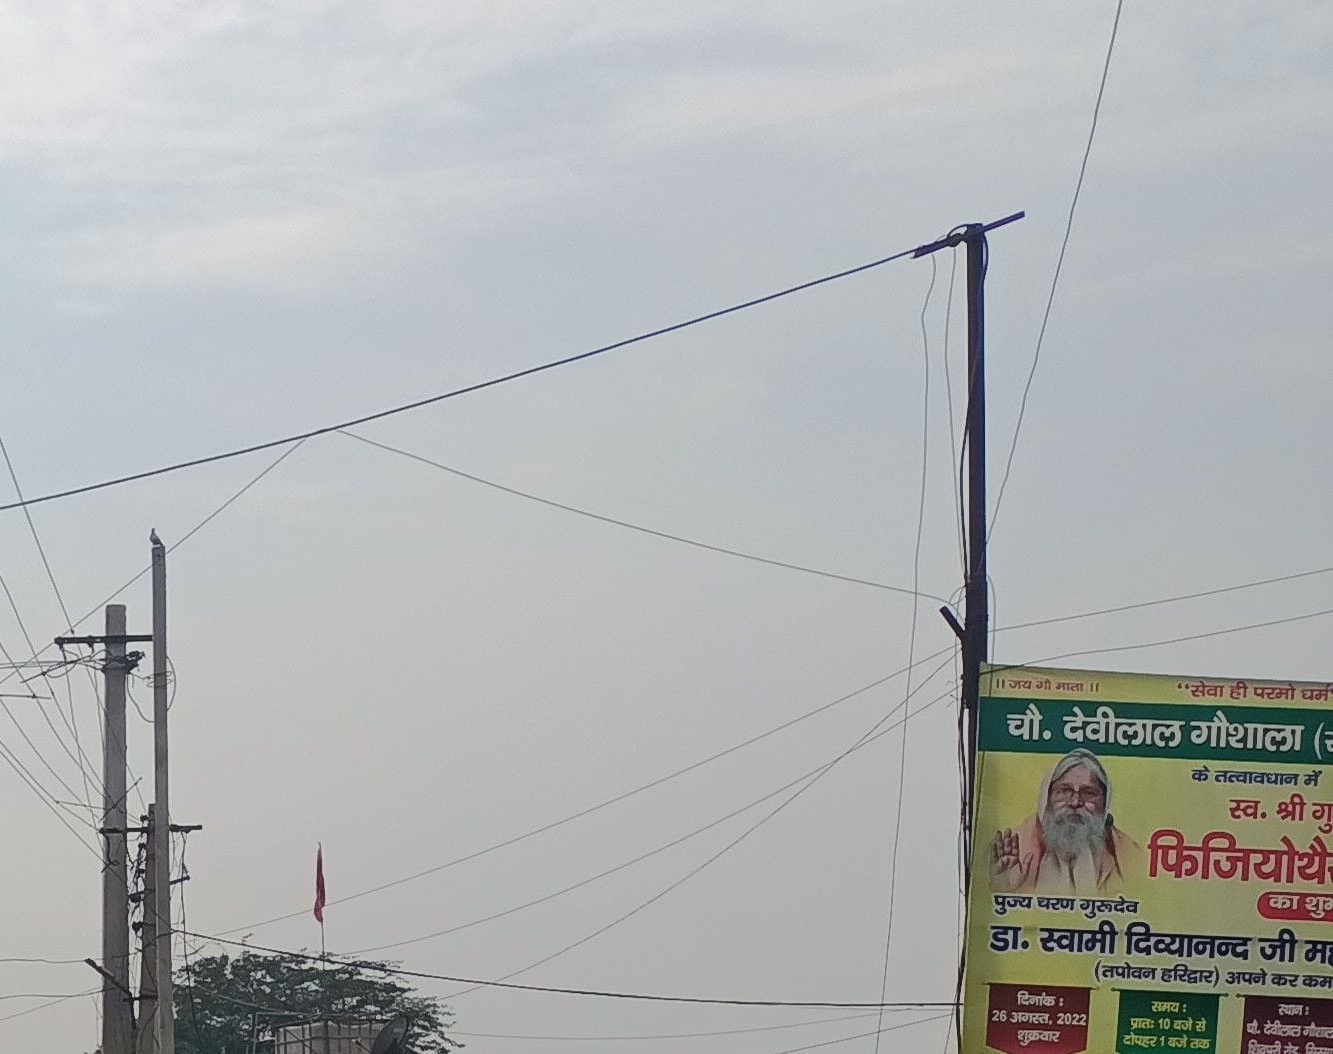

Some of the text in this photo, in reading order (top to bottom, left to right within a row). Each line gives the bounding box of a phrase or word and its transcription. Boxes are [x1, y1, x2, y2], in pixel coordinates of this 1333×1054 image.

[1008, 678, 1032, 690] जय
[1055, 681, 1084, 692] माता
[1229, 680, 1248, 699] ही
[1253, 683, 1297, 701] परमो
[1006, 702, 1052, 741] चौ.
[1062, 705, 1186, 748] देवीलाल
[1190, 709, 1305, 752] गौशाला
[1191, 765, 1322, 787] के तत्वावधान में
[1228, 798, 1267, 820] स्व.
[1275, 793, 1307, 822] श्री
[1037, 896, 1076, 911] चरण
[1268, 894, 1299, 910] का
[990, 925, 1030, 952] डा.
[1039, 920, 1118, 954] स्वामी
[1124, 921, 1252, 960] दिव्यानन्द
[1258, 928, 1298, 962] जी
[1095, 960, 1157, 981] (तपोवन
[1160, 963, 1220, 987] हरिद्वार)
[1225, 968, 1267, 985] अपने
[1271, 973, 1299, 987] कर
[1017, 990, 1057, 1007] दिनांक
[1150, 1000, 1180, 1013] समय
[991, 1009, 1087, 1026] 26 अगस्त, 2022
[1278, 1003, 1304, 1016] स्थान
[1158, 1018, 1171, 1030] 10
[1173, 1017, 1193, 1031] बजे
[1195, 1018, 1207, 1032] से
[1017, 1029, 1061, 1046] शुक्रवार
[1122, 1032, 1158, 1048] दोपहर
[1160, 1035, 1165, 1047] 1
[1167, 1034, 1188, 1049] बजे
